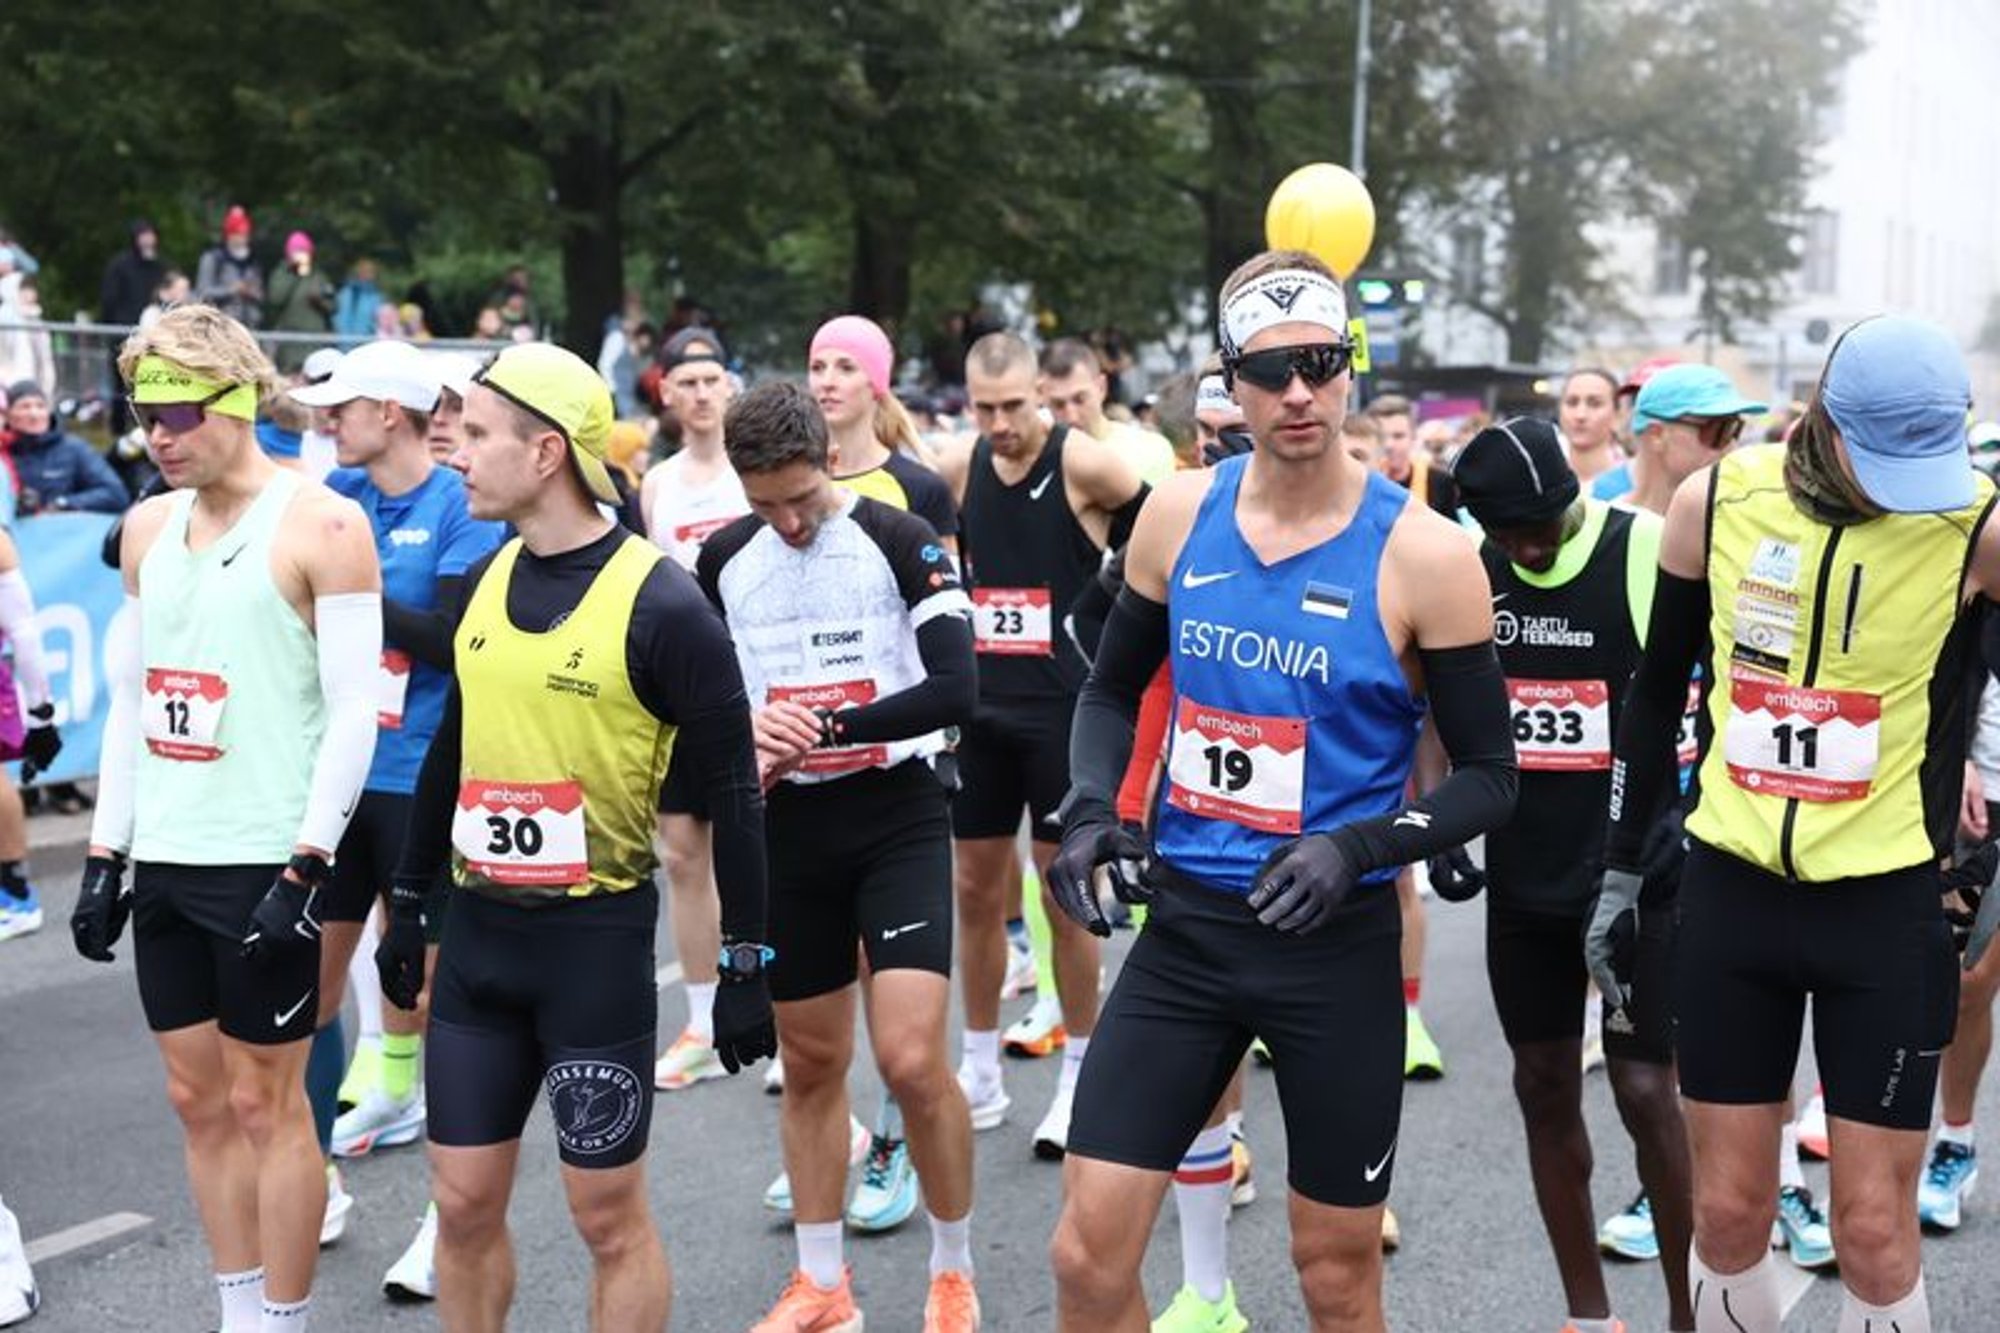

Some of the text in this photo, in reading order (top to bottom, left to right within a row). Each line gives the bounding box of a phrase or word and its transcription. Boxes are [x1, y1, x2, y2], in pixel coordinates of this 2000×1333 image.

[993, 610, 1023, 634] 23
[1521, 616, 1569, 632] TARTU
[1521, 631, 1594, 647] TEENUSED
[1179, 619, 1328, 685] ESTONIA
[1516, 684, 1574, 699] embach
[1764, 691, 1839, 713] embach
[165, 700, 190, 736] 12
[1196, 714, 1262, 739] embach
[1513, 708, 1583, 745] 633
[1772, 723, 1818, 769] 11
[1203, 745, 1253, 792] 19
[481, 786, 544, 804] embach
[486, 815, 543, 856] 30
